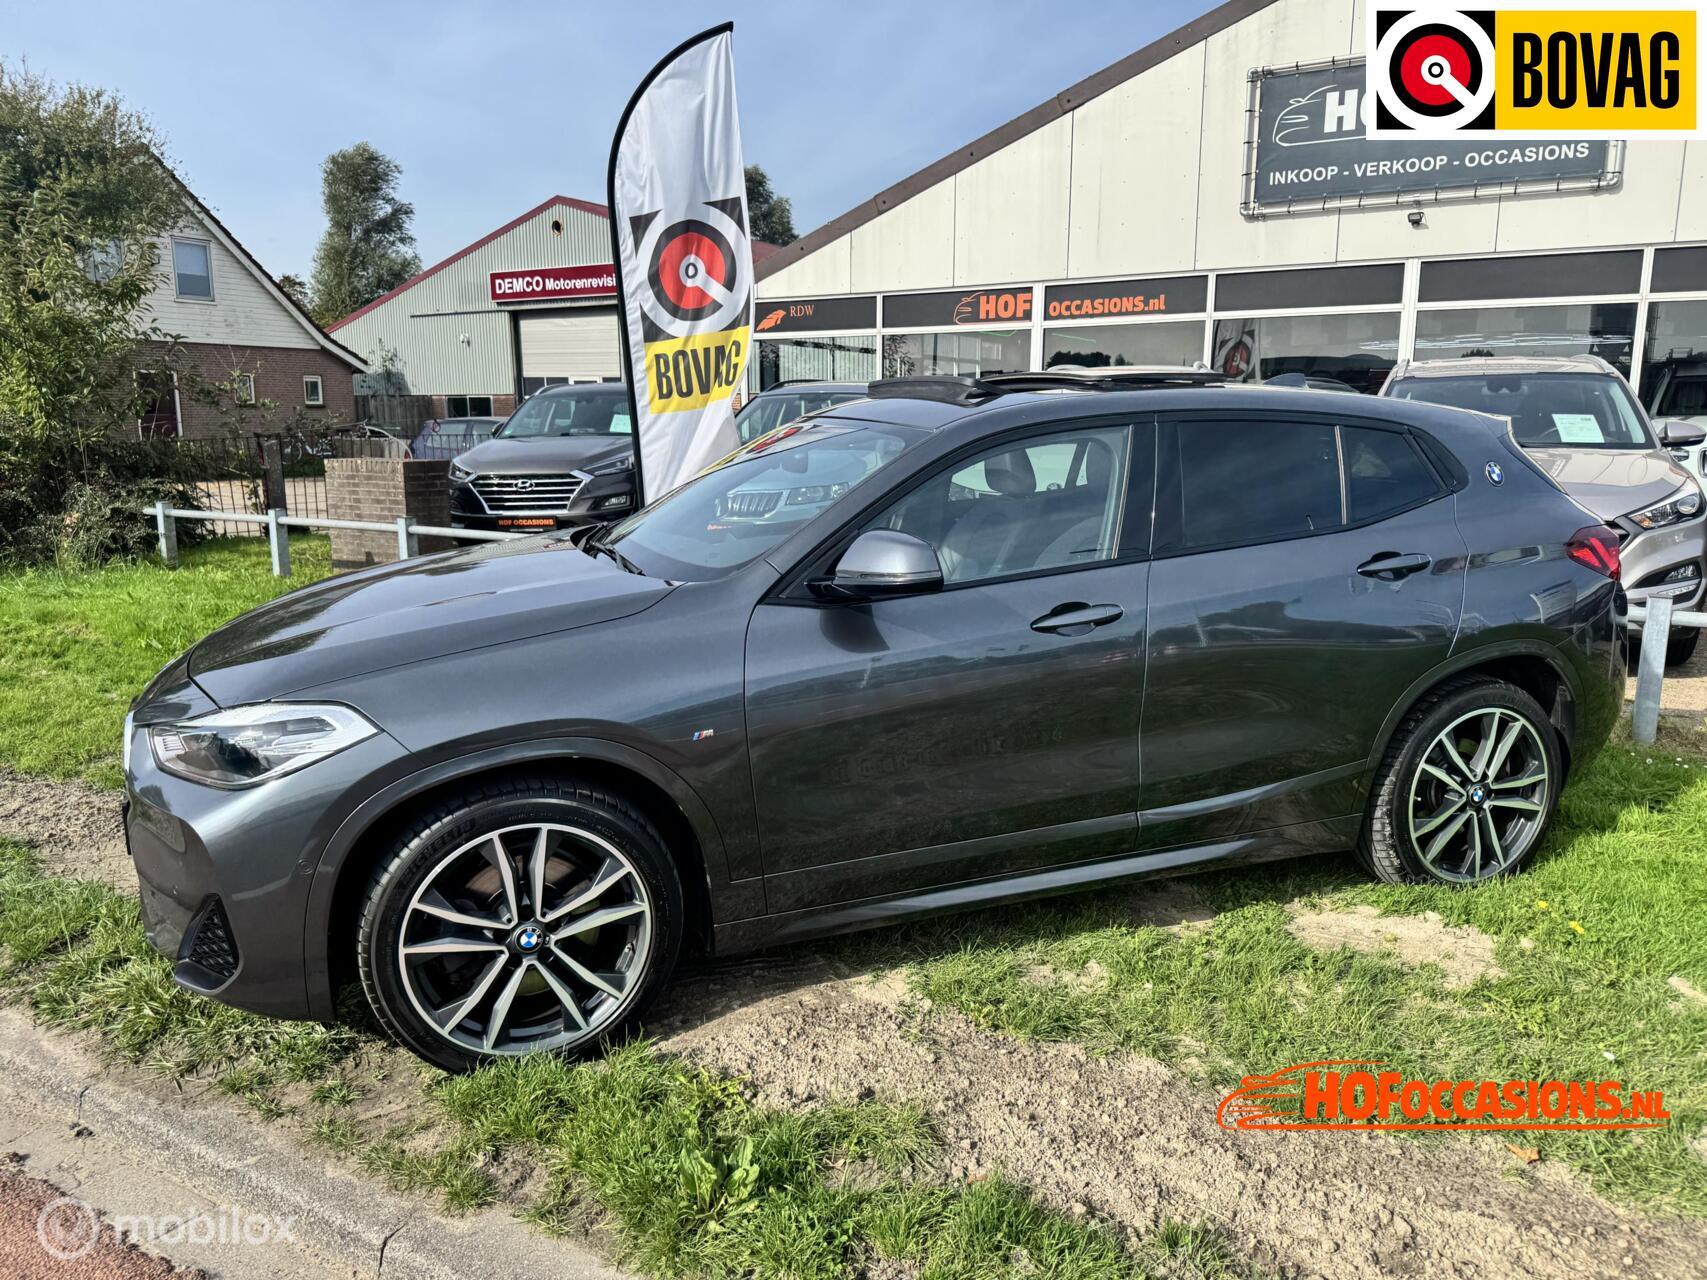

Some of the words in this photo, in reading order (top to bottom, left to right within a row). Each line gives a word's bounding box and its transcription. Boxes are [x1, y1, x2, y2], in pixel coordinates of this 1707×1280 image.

[1324, 89, 1366, 133] H
[1269, 165, 1338, 186] INKOOP
[1353, 155, 1448, 178] VERKOOP
[1464, 142, 1590, 168] OCCASIONS
[495, 276, 543, 294] DEMCO
[545, 274, 616, 291] Motorenrevisi
[790, 305, 814, 317] RDW
[979, 293, 1032, 319] HOF
[1048, 294, 1166, 317] OCCASIONS.nl
[654, 340, 741, 400] BOVAG
